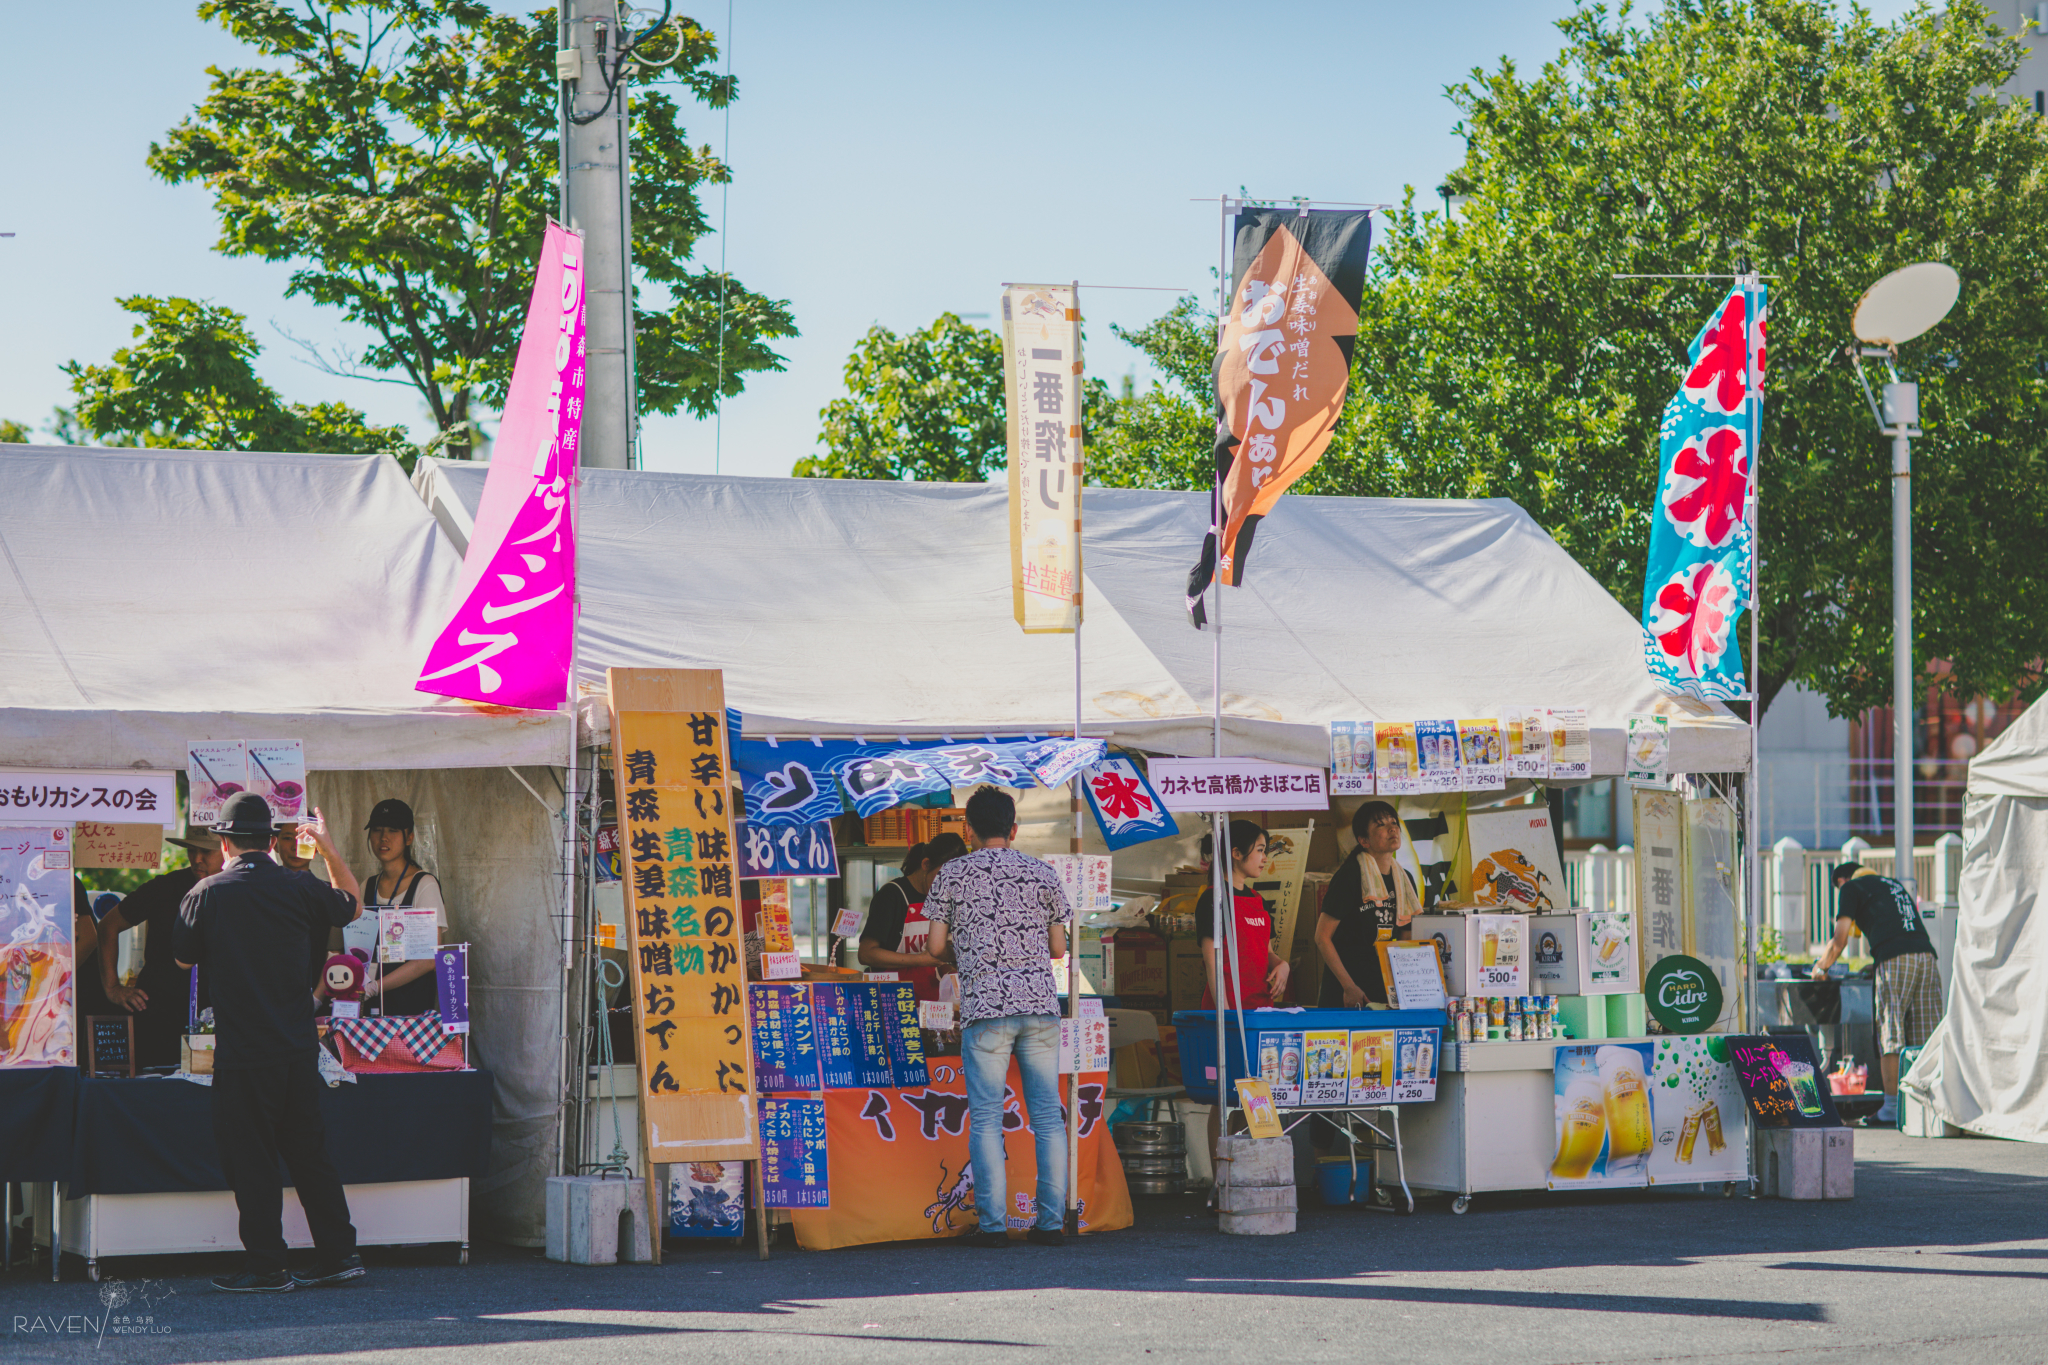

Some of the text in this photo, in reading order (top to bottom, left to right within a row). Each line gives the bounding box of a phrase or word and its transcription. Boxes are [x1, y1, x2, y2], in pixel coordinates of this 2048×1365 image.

[1308, 275, 1317, 331] あおもり
[1289, 273, 1310, 401] 生姜味噌だれ
[561, 303, 586, 450] 青森市特産
[1091, 771, 1153, 819] 氷
[1160, 774, 1321, 794] カネセ高橋かまぼこ店
[77, 822, 116, 837] 大人な
[192, 810, 214, 823] ¥600
[86, 839, 140, 850] スムージー
[745, 827, 829, 871] おでん
[664, 827, 704, 975] 青森名物
[686, 712, 746, 1093] 甘辛い味噌のかかった
[626, 749, 680, 1093] 青森生姜味噌おでん
[1244, 917, 1265, 927] KIRIN
[447, 966, 459, 1020] あおもりカシス
[1658, 981, 1708, 1008] Cidre
[1668, 982, 1697, 992] HARD
[755, 990, 771, 1059] すり身天セット
[767, 990, 786, 1069] 青森食材を使った
[791, 990, 814, 1055] イカメンチ
[835, 986, 851, 1056] いかなんこつの
[869, 988, 886, 1066] もちとチーズの
[897, 988, 925, 1064] お好み焼き天
[1681, 1016, 1700, 1024] KIRIN
[1093, 1021, 1106, 1055] かき氷
[1352, 1035, 1382, 1055] WHITE HORSE
[1568, 1046, 1599, 1056] 一番搾り
[1735, 1046, 1766, 1067] りんご
[795, 1074, 816, 1088] 300円
[863, 1071, 890, 1086] 1本300円
[904, 1069, 926, 1083] 300円
[1307, 1080, 1343, 1088] 缶チューハイ
[1742, 1066, 1780, 1088] シードル
[779, 1102, 791, 1137] イカ入り
[814, 1104, 825, 1150] ジャンボ
[765, 1102, 779, 1183] 具だくさん焼きそば
[802, 1104, 815, 1186] こんにゃく田楽
[797, 1190, 827, 1204] 1本150円
